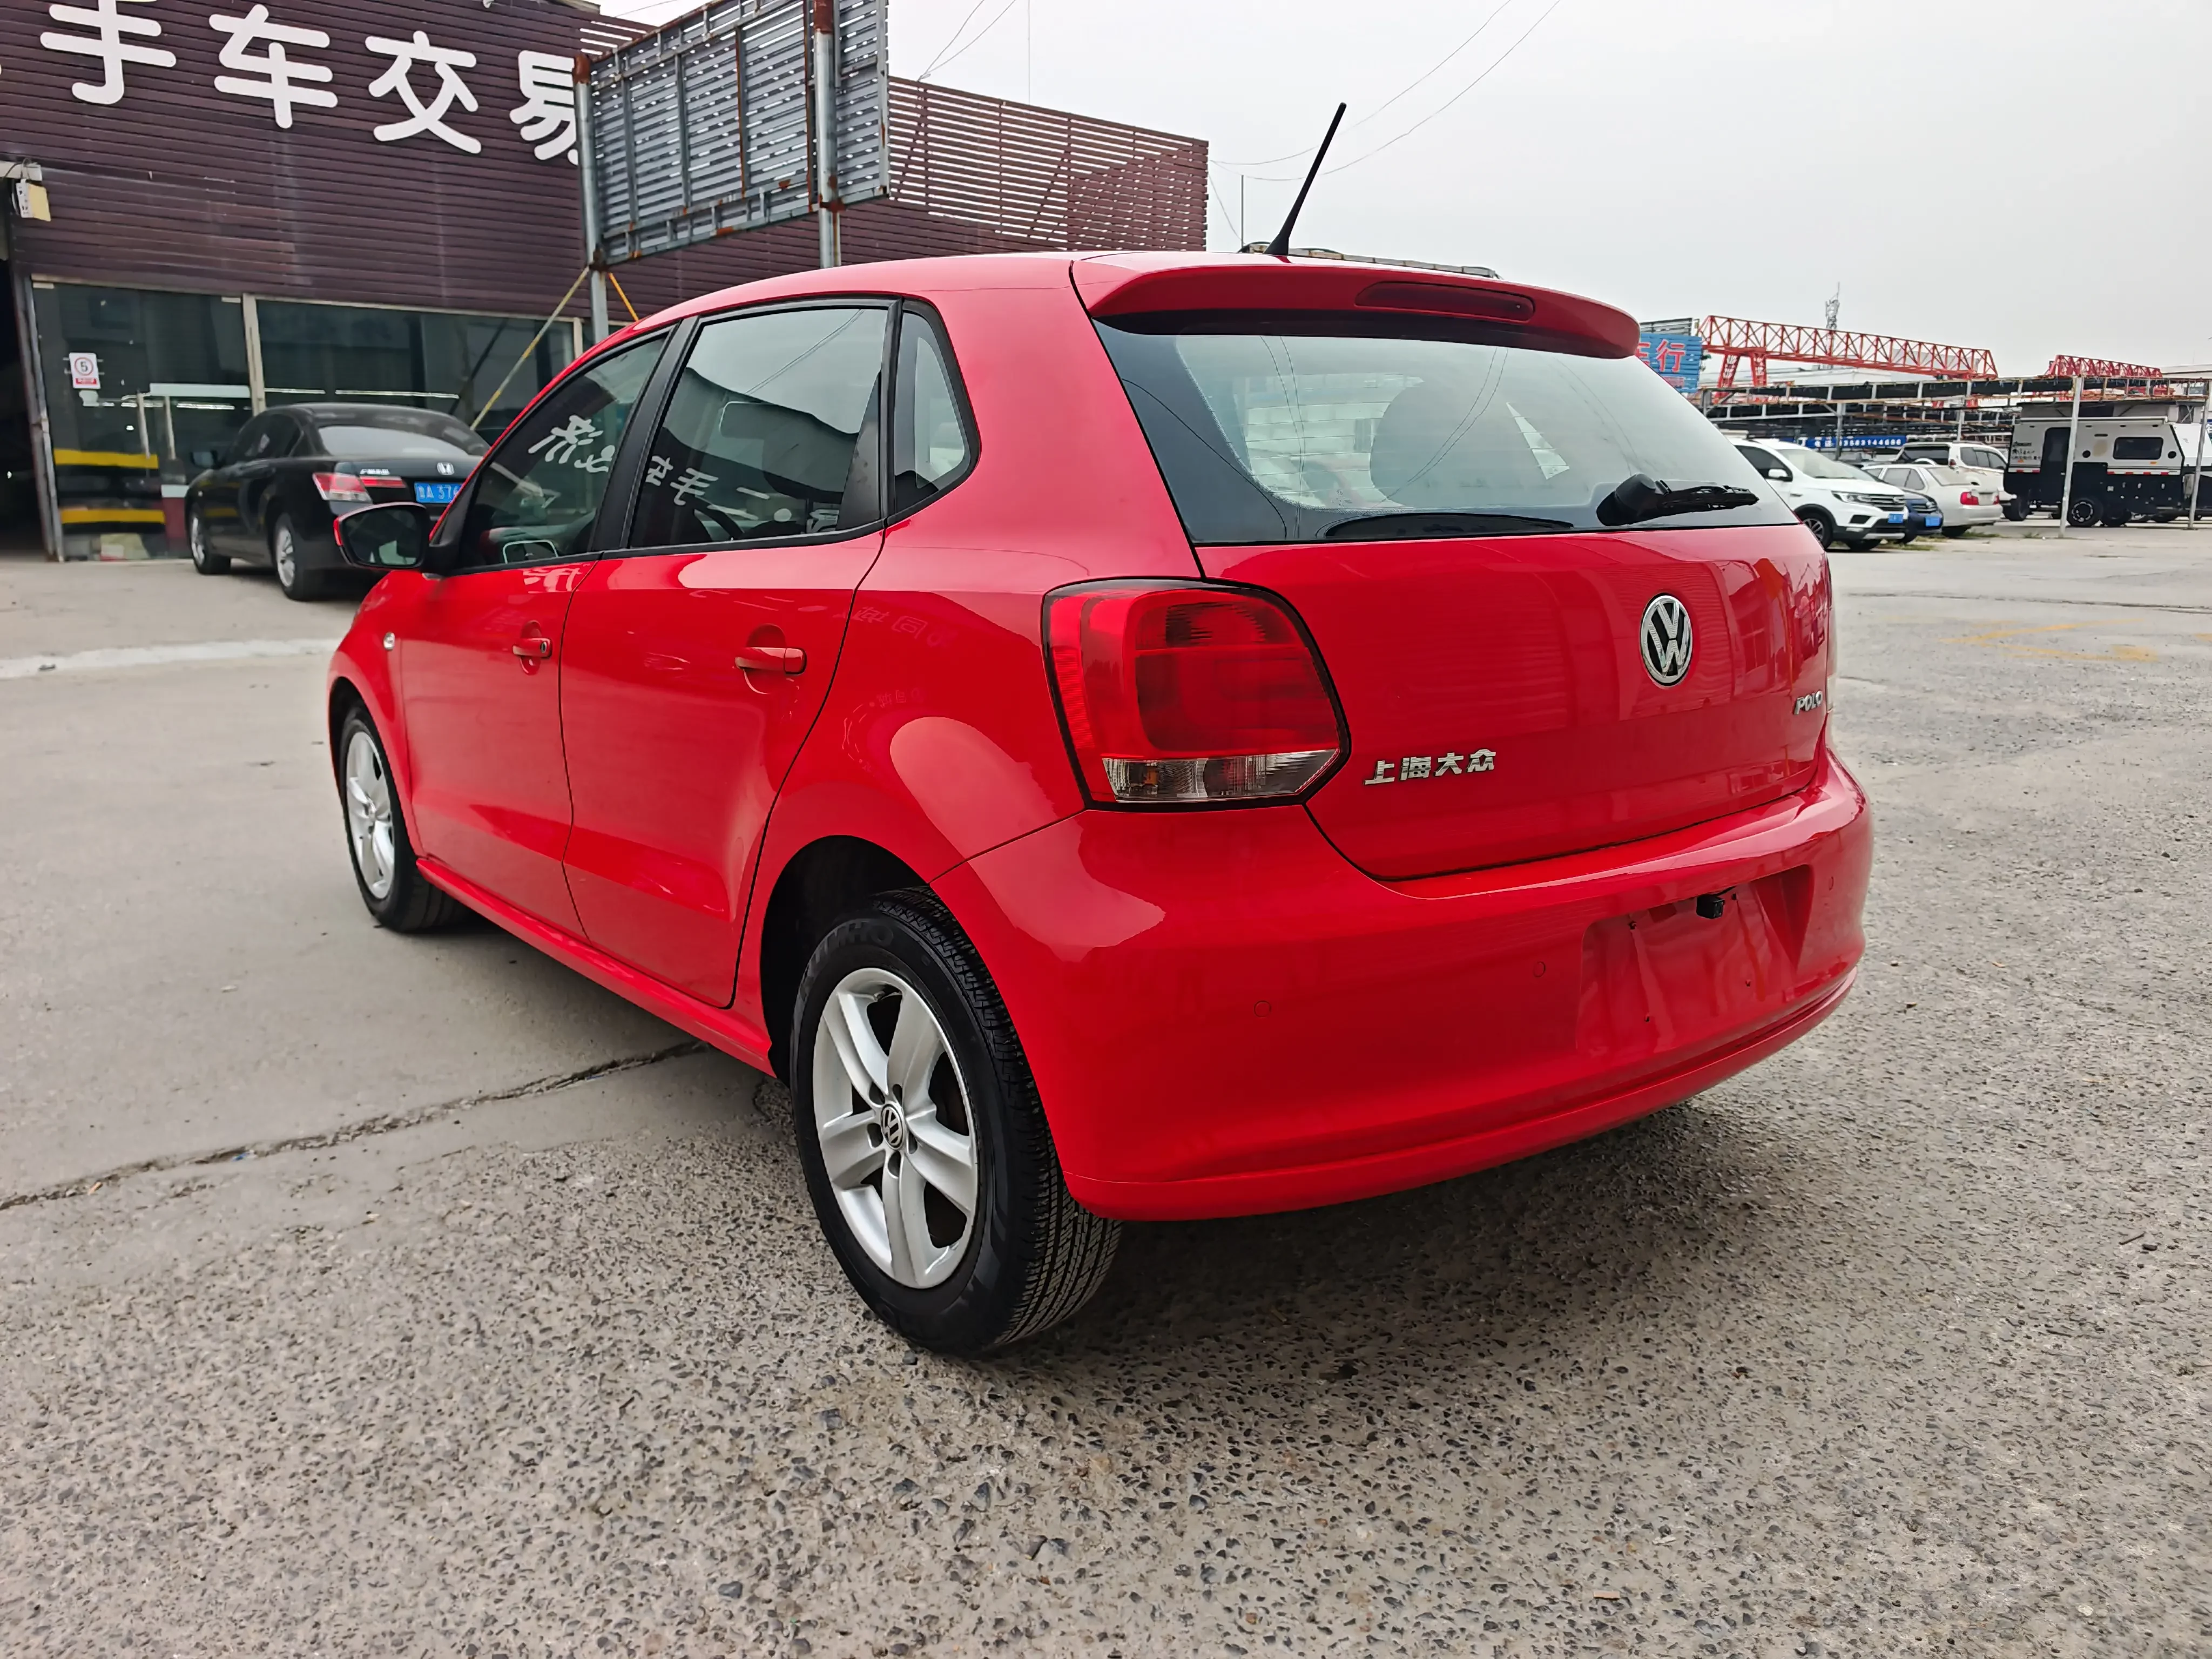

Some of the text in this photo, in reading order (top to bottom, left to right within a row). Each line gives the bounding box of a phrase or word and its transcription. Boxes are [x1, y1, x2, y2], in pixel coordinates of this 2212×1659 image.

[40, 0, 579, 166] 手车交易
[1794, 690, 1823, 715] POLO
[1364, 748, 1496, 785] 上海大众
